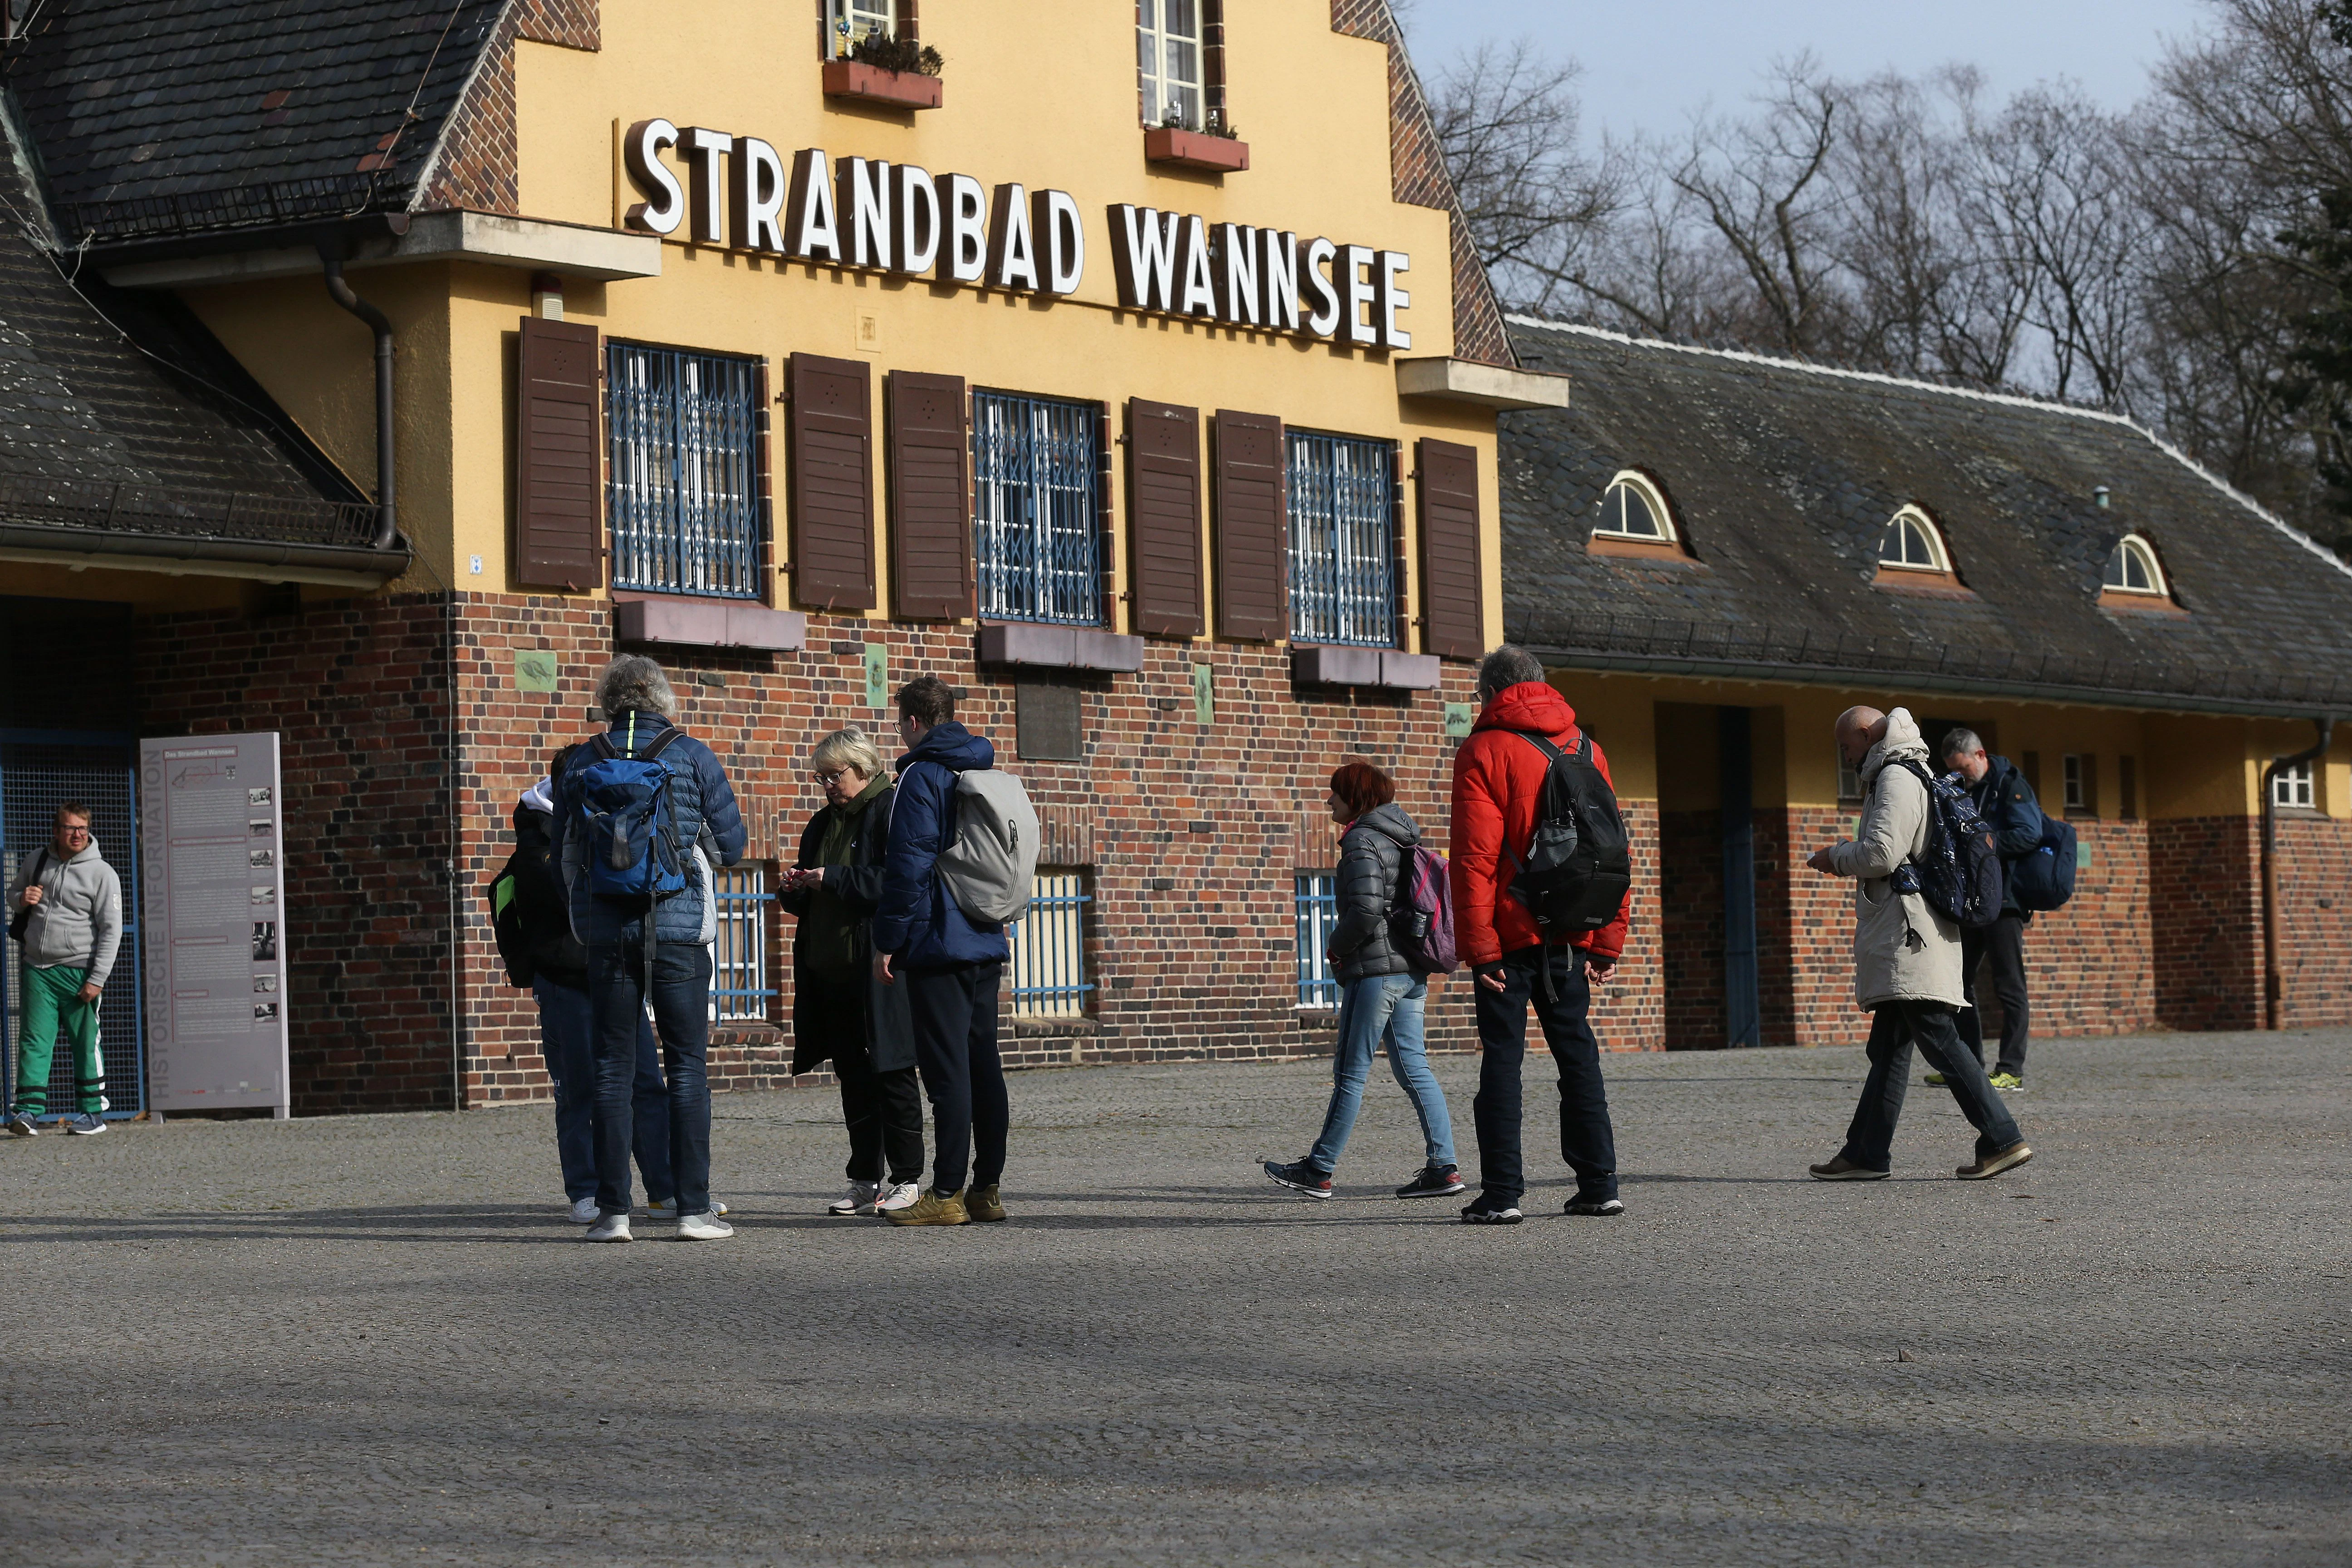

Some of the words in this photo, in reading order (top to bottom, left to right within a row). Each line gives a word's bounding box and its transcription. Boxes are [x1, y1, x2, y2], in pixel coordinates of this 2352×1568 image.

[641, 118, 1084, 294] STRANDBAD
[1120, 203, 1411, 350] WANNSEE
[144, 750, 164, 922] INFORMATION
[149, 931, 169, 1099] HISTORISCHE
